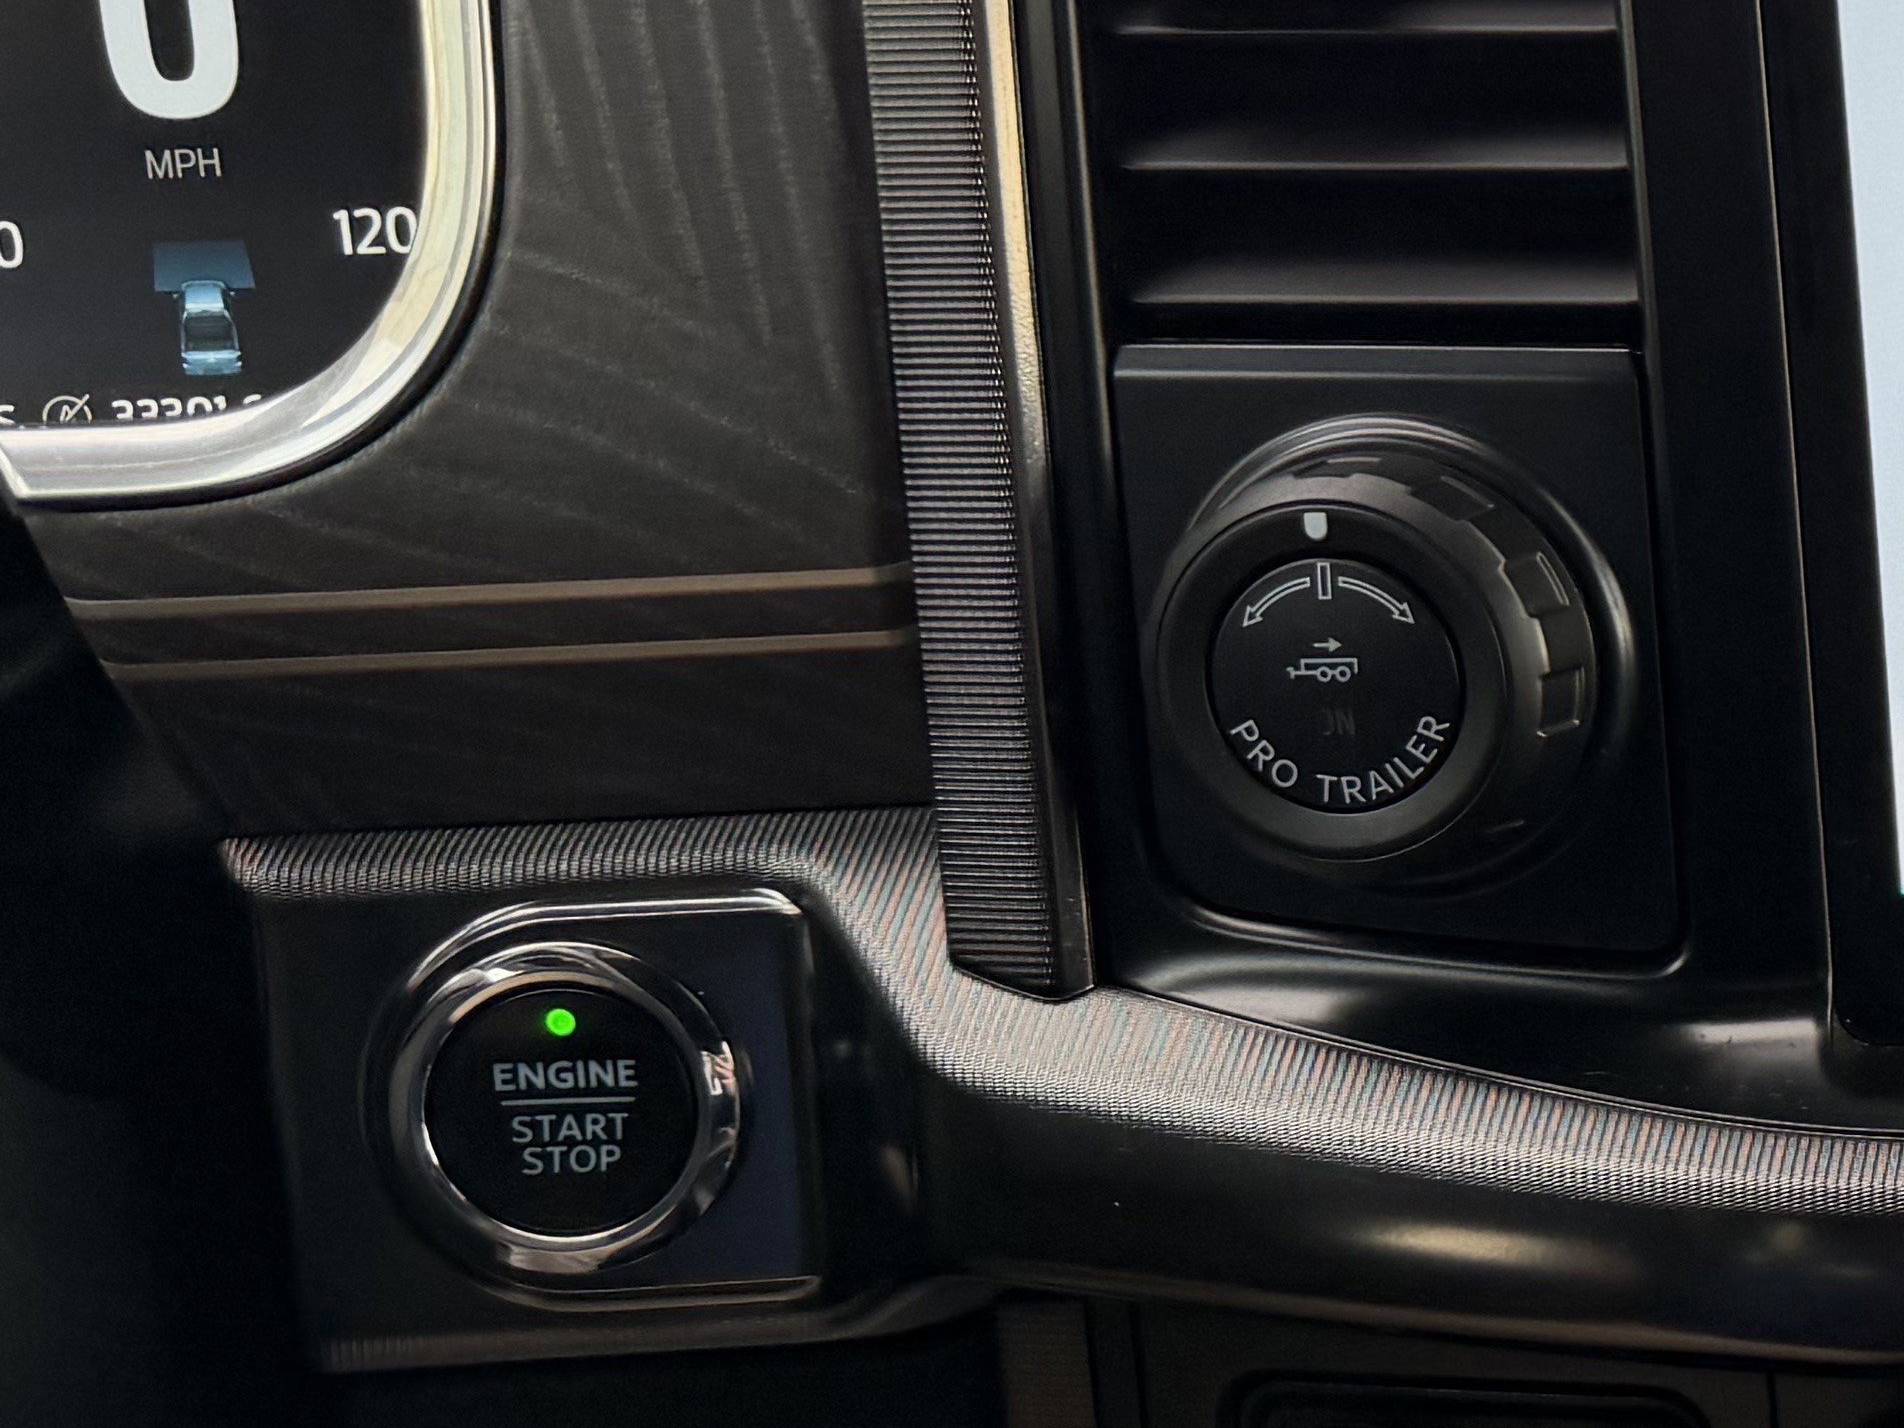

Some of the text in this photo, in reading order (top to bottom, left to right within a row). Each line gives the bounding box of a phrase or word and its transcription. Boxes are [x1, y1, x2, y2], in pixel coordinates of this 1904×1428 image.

[144, 148, 222, 182] MPH
[333, 206, 417, 256] 120
[1229, 714, 1451, 805] PRO TRAILER
[492, 1059, 639, 1092] ENGINE
[511, 1113, 629, 1144] START
[522, 1145, 623, 1176] STOP
